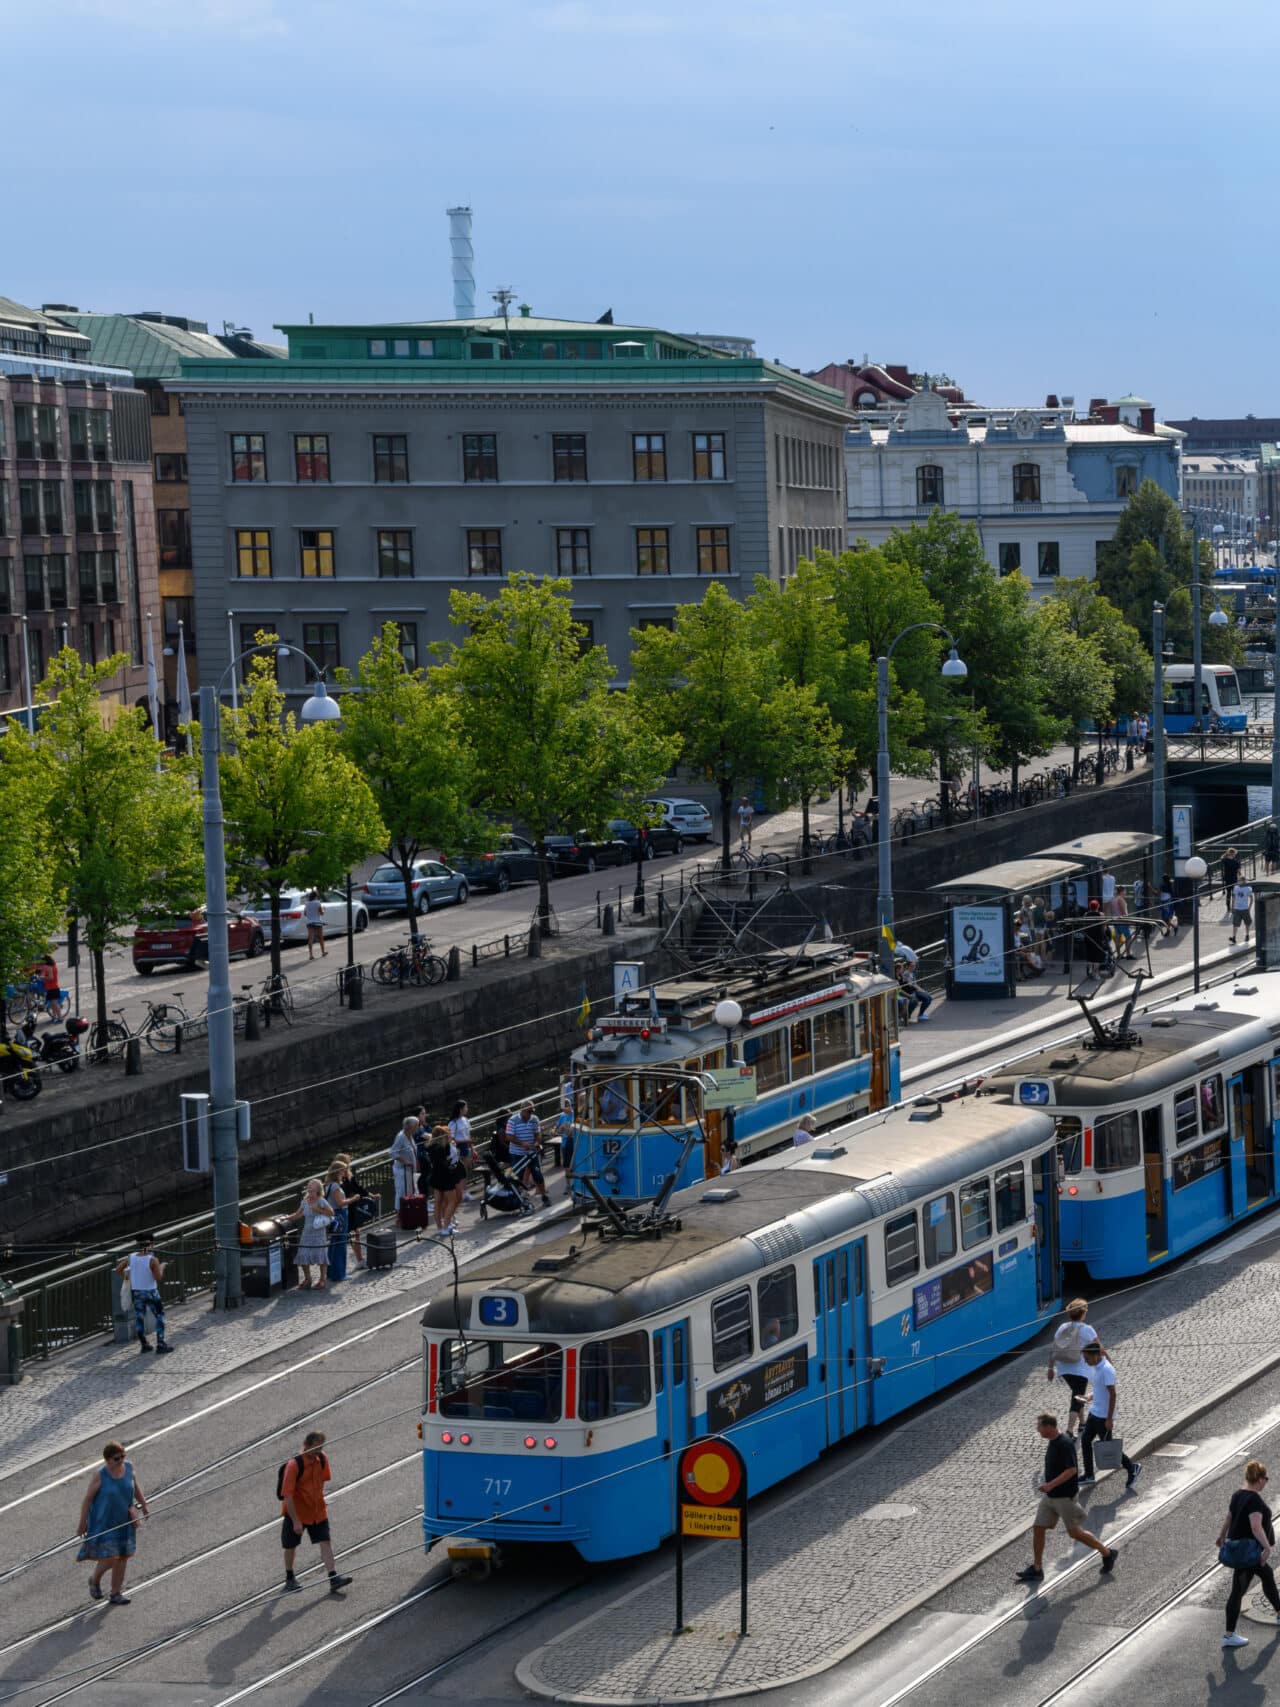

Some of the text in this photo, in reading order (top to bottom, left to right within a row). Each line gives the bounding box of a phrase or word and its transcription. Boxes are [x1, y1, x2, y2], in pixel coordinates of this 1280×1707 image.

[621, 969, 632, 988] A
[1030, 1084, 1040, 1102] 3
[606, 1141, 620, 1153] 12
[493, 1298, 507, 1321] 3
[484, 1478, 512, 1495] 717
[717, 1511, 738, 1521] buss
